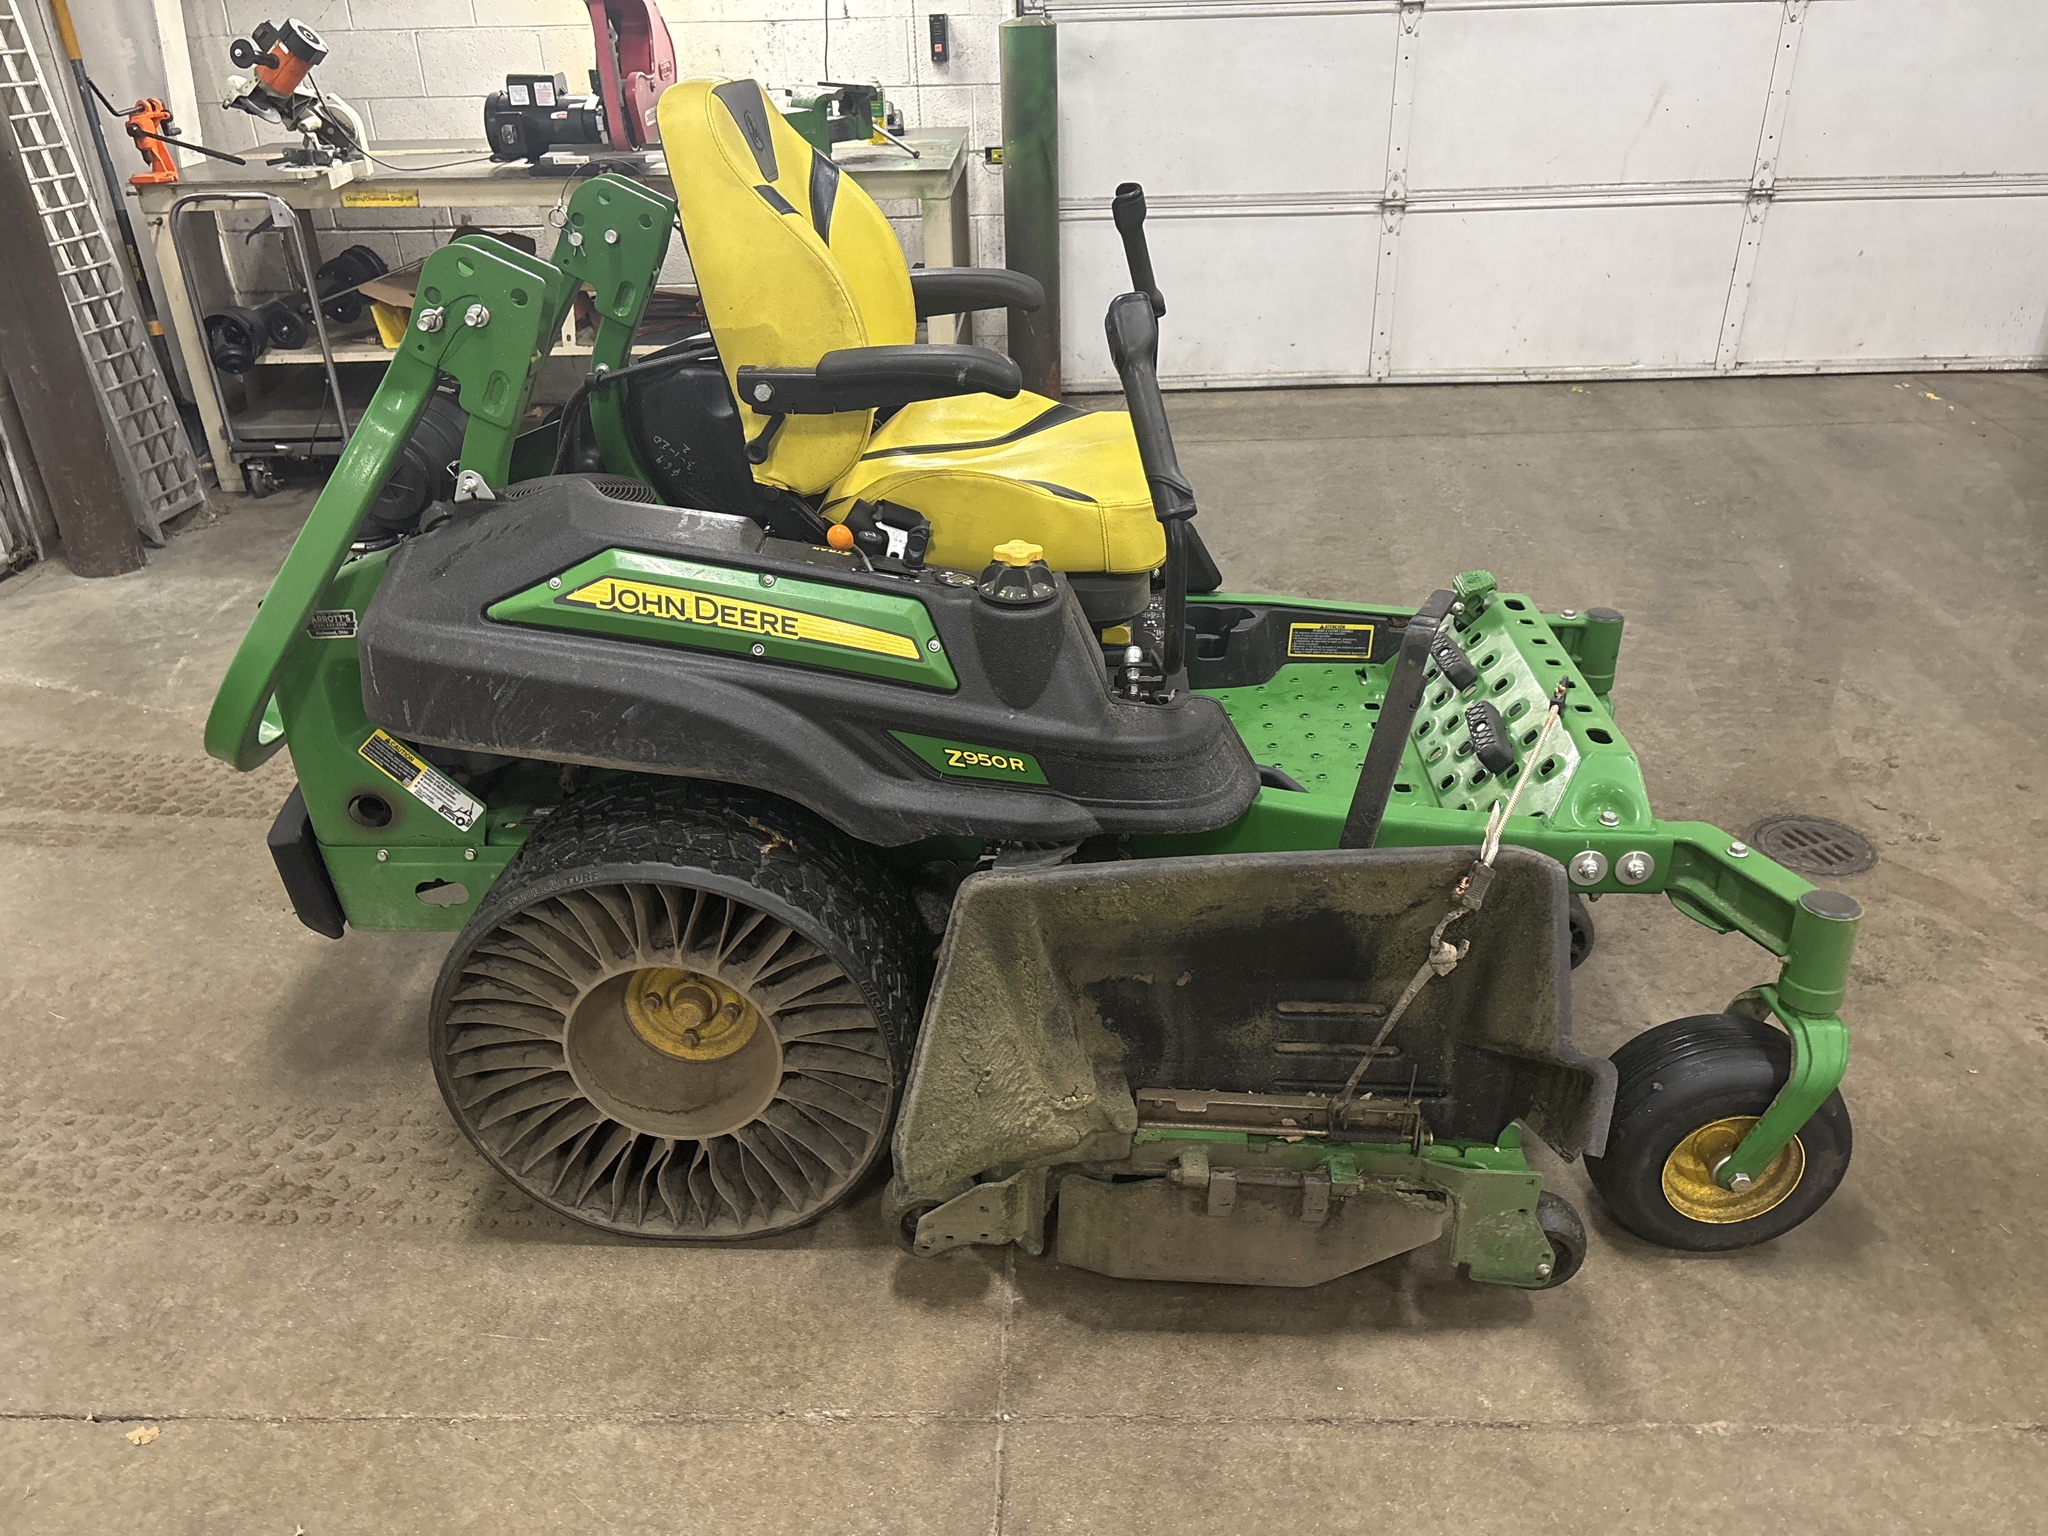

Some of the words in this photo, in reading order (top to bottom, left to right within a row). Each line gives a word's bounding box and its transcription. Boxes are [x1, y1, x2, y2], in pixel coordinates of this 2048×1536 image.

[599, 583, 685, 617] JOHN
[694, 596, 799, 637] DEERE
[389, 740, 415, 763] CAUTION
[943, 748, 1027, 772] Z950R
[565, 870, 599, 885] TURF
[859, 978, 899, 1045] MICHELIN
